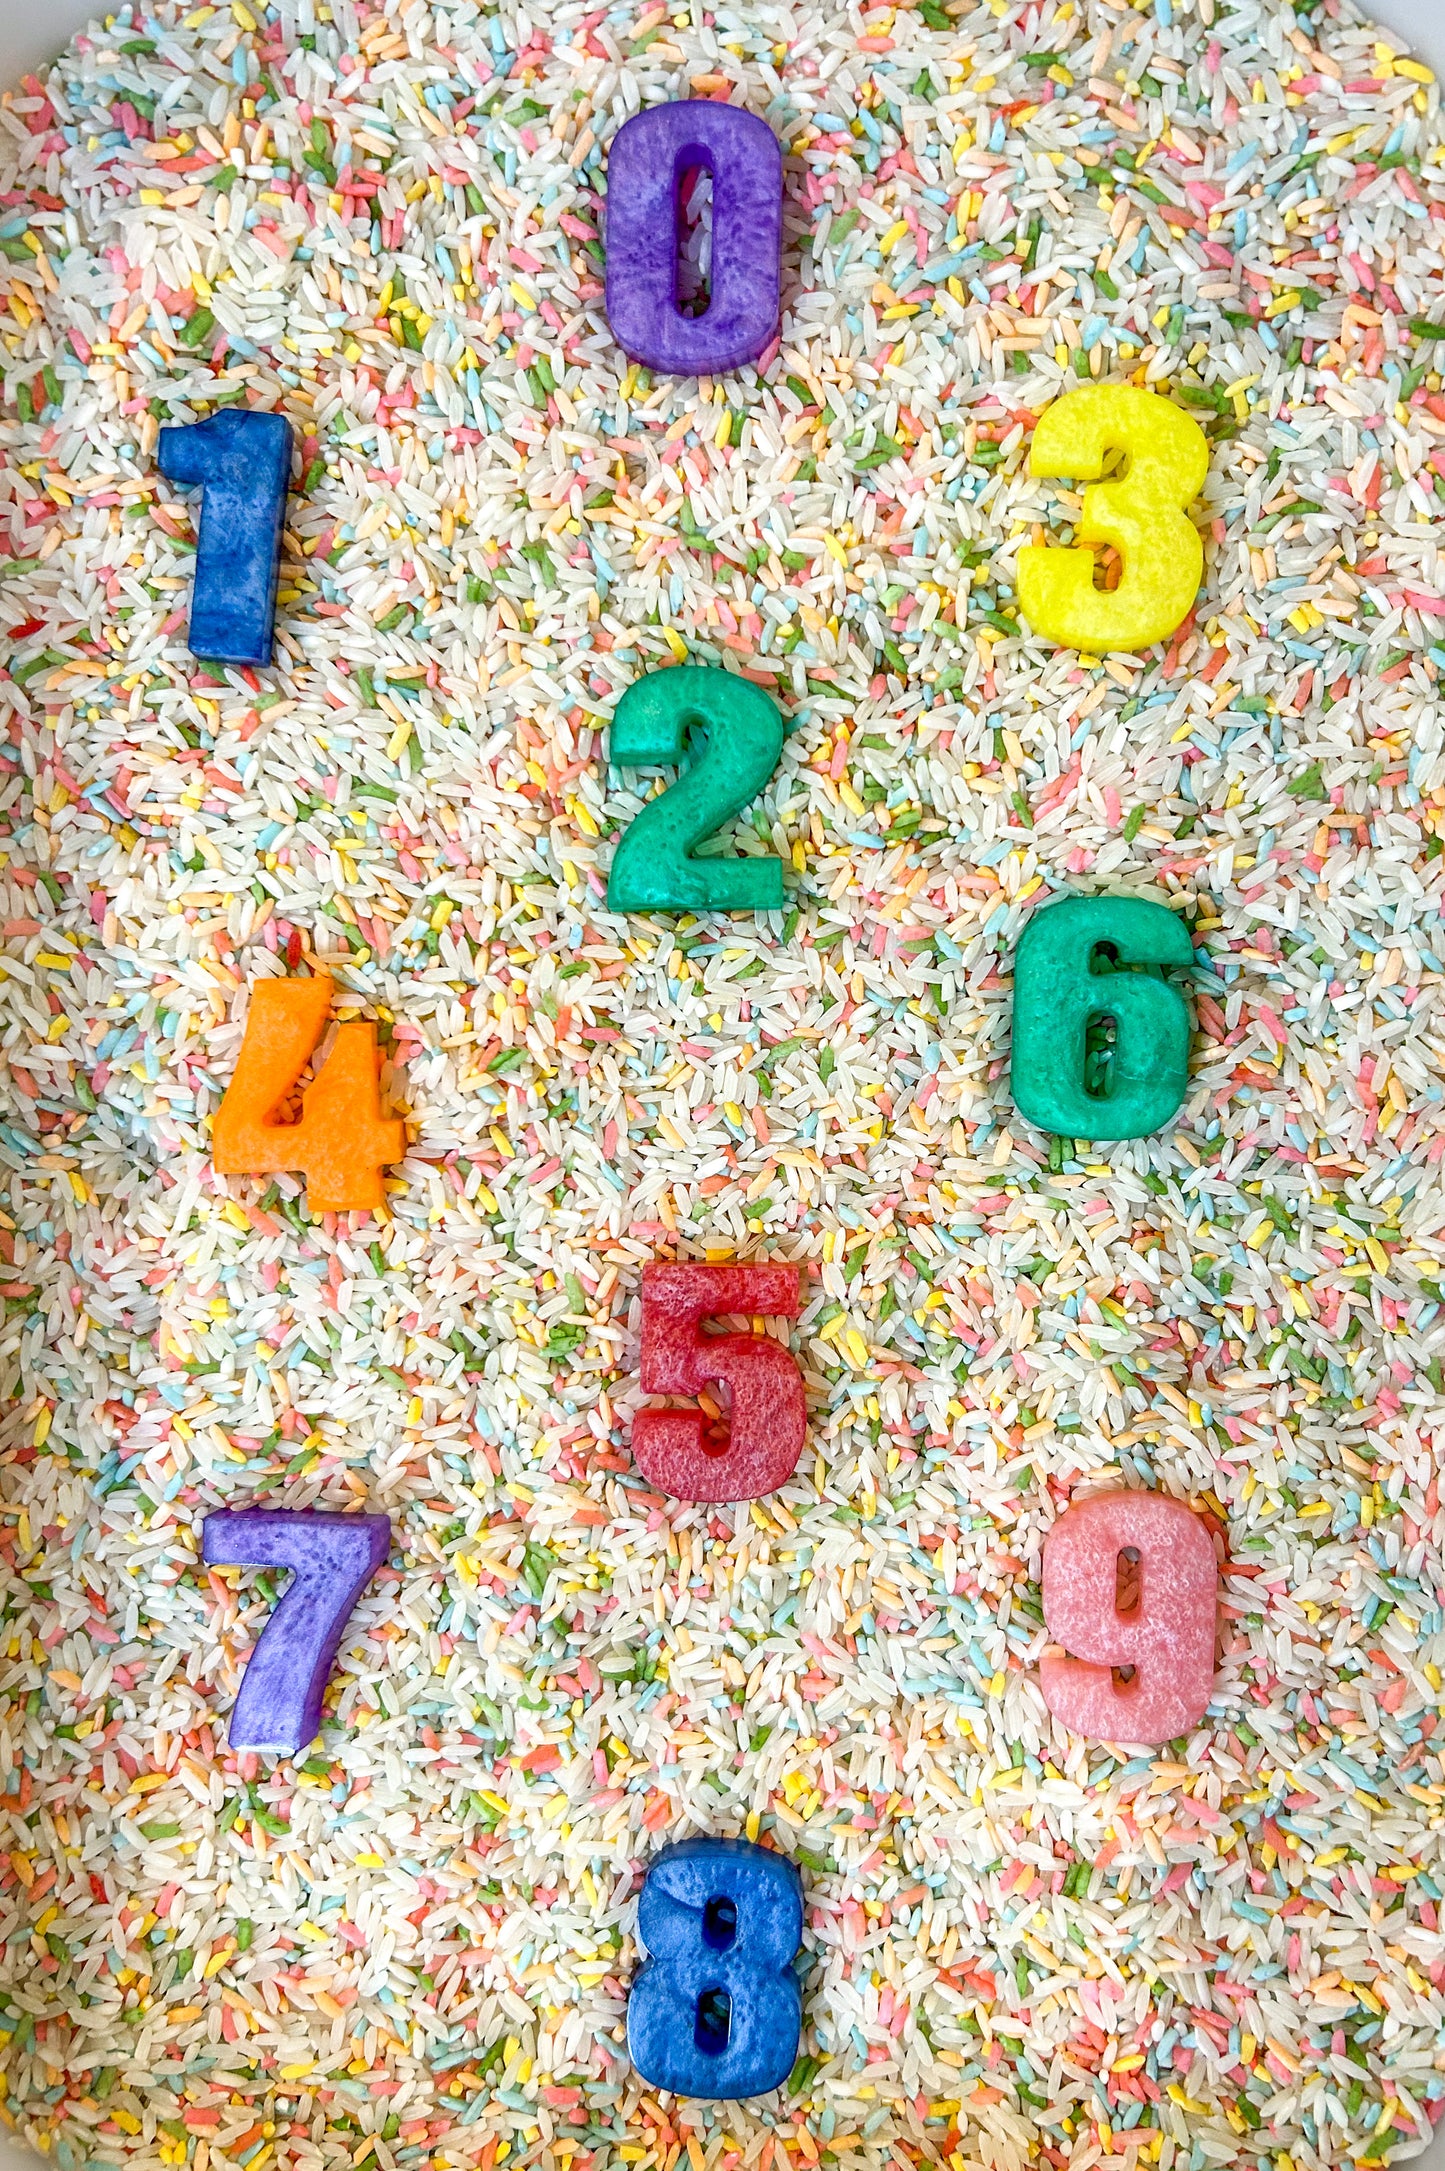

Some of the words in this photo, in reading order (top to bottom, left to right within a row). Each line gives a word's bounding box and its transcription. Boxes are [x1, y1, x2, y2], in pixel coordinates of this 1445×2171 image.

[606, 100, 783, 376] 0
[158, 404, 293, 666] 1
[1016, 383, 1211, 652] 3
[606, 666, 785, 912] 2
[210, 976, 406, 1212] 4
[1012, 894, 1196, 1140] 6
[630, 1258, 808, 1503] 5
[202, 1506, 390, 1755] 7
[1039, 1491, 1218, 1744] 9
[627, 1838, 804, 2098] 8
